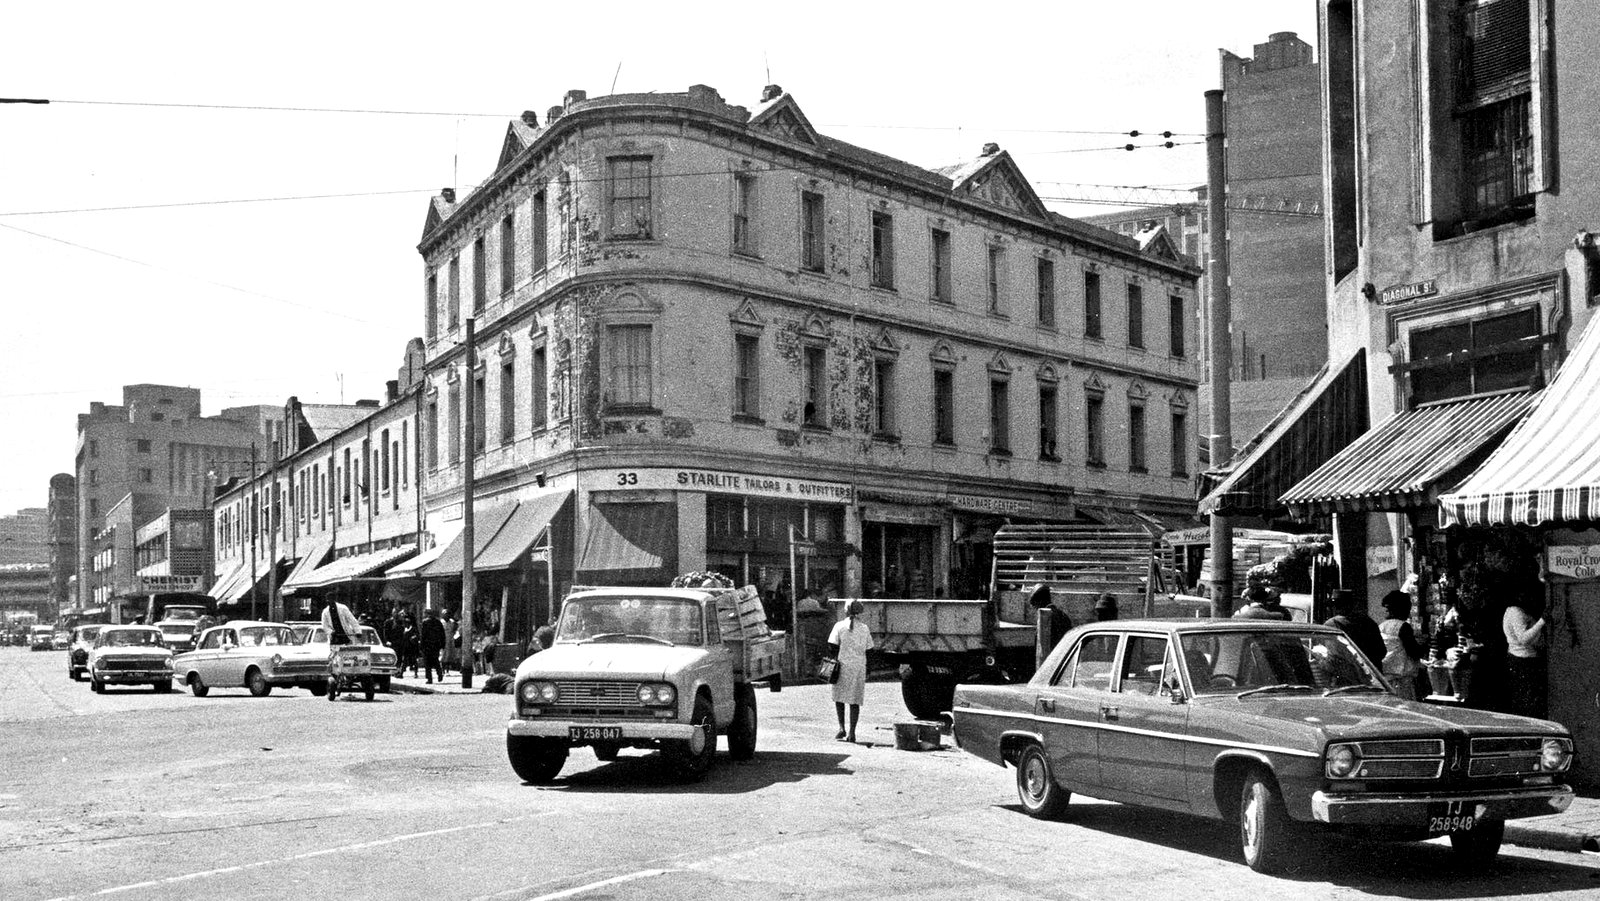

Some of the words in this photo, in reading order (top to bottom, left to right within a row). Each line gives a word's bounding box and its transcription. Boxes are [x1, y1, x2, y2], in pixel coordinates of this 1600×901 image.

[1382, 284, 1421, 302] DIAGONAL
[617, 472, 638, 486] 33
[677, 471, 740, 488] STARLITE
[744, 478, 781, 490] TAILORS
[785, 482, 792, 492] &
[799, 483, 851, 497] OUTFITTERS
[1555, 554, 1582, 569] Royal
[1584, 555, 1600, 566] Cro
[1575, 566, 1596, 577] Cola
[142, 576, 198, 584] CHEMIST
[571, 728, 581, 739] TJ
[1447, 801, 1462, 815] TJ
